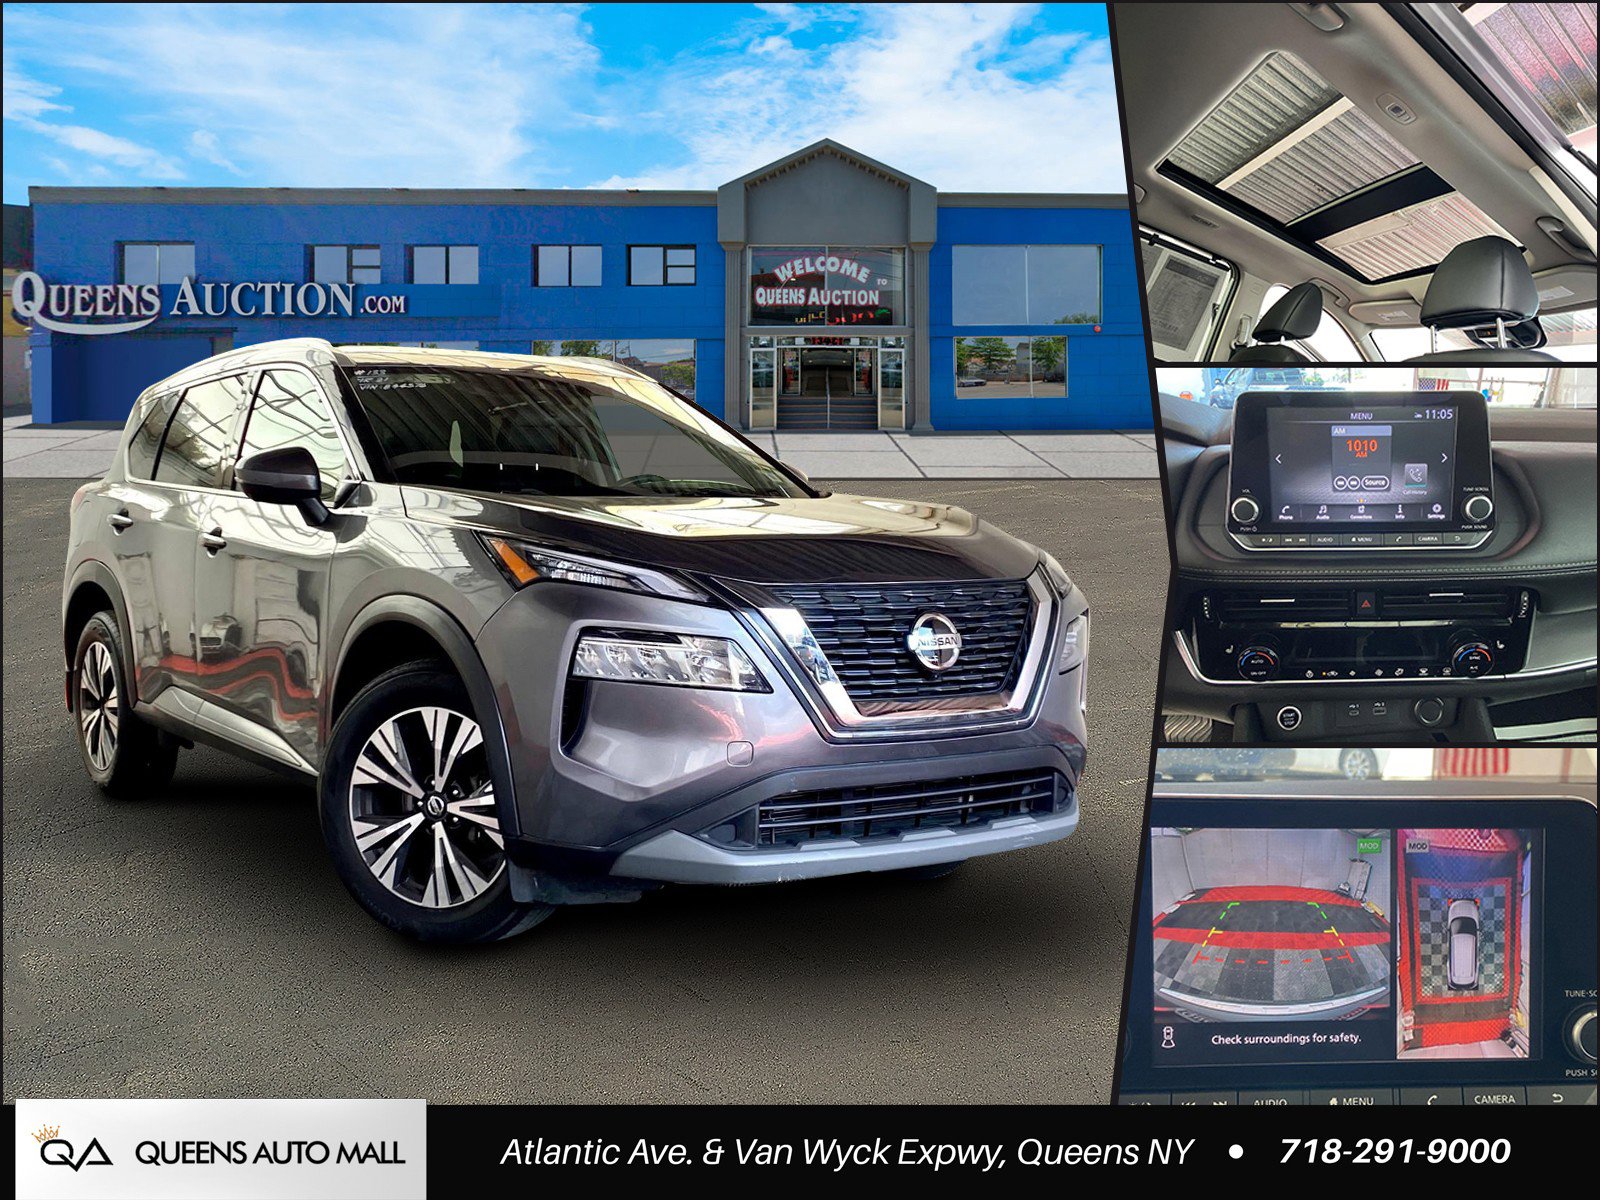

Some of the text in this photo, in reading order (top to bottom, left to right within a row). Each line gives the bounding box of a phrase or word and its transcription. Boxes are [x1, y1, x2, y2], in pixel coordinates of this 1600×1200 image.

[773, 255, 871, 284] WELCOME
[755, 286, 879, 307] QUEENS AUCTION
[11, 271, 160, 336] QUEENS
[1350, 408, 1453, 420] MENU 11:05
[1346, 439, 1378, 452] 1010
[1364, 478, 1387, 486] Source
[917, 637, 959, 647] NISSAN
[1211, 1032, 1362, 1045] Check surroundings for safety.
[1565, 1069, 1588, 1077] PUSH
[1342, 1097, 1374, 1106] MENU
[1474, 1094, 1516, 1104] CAMERA
